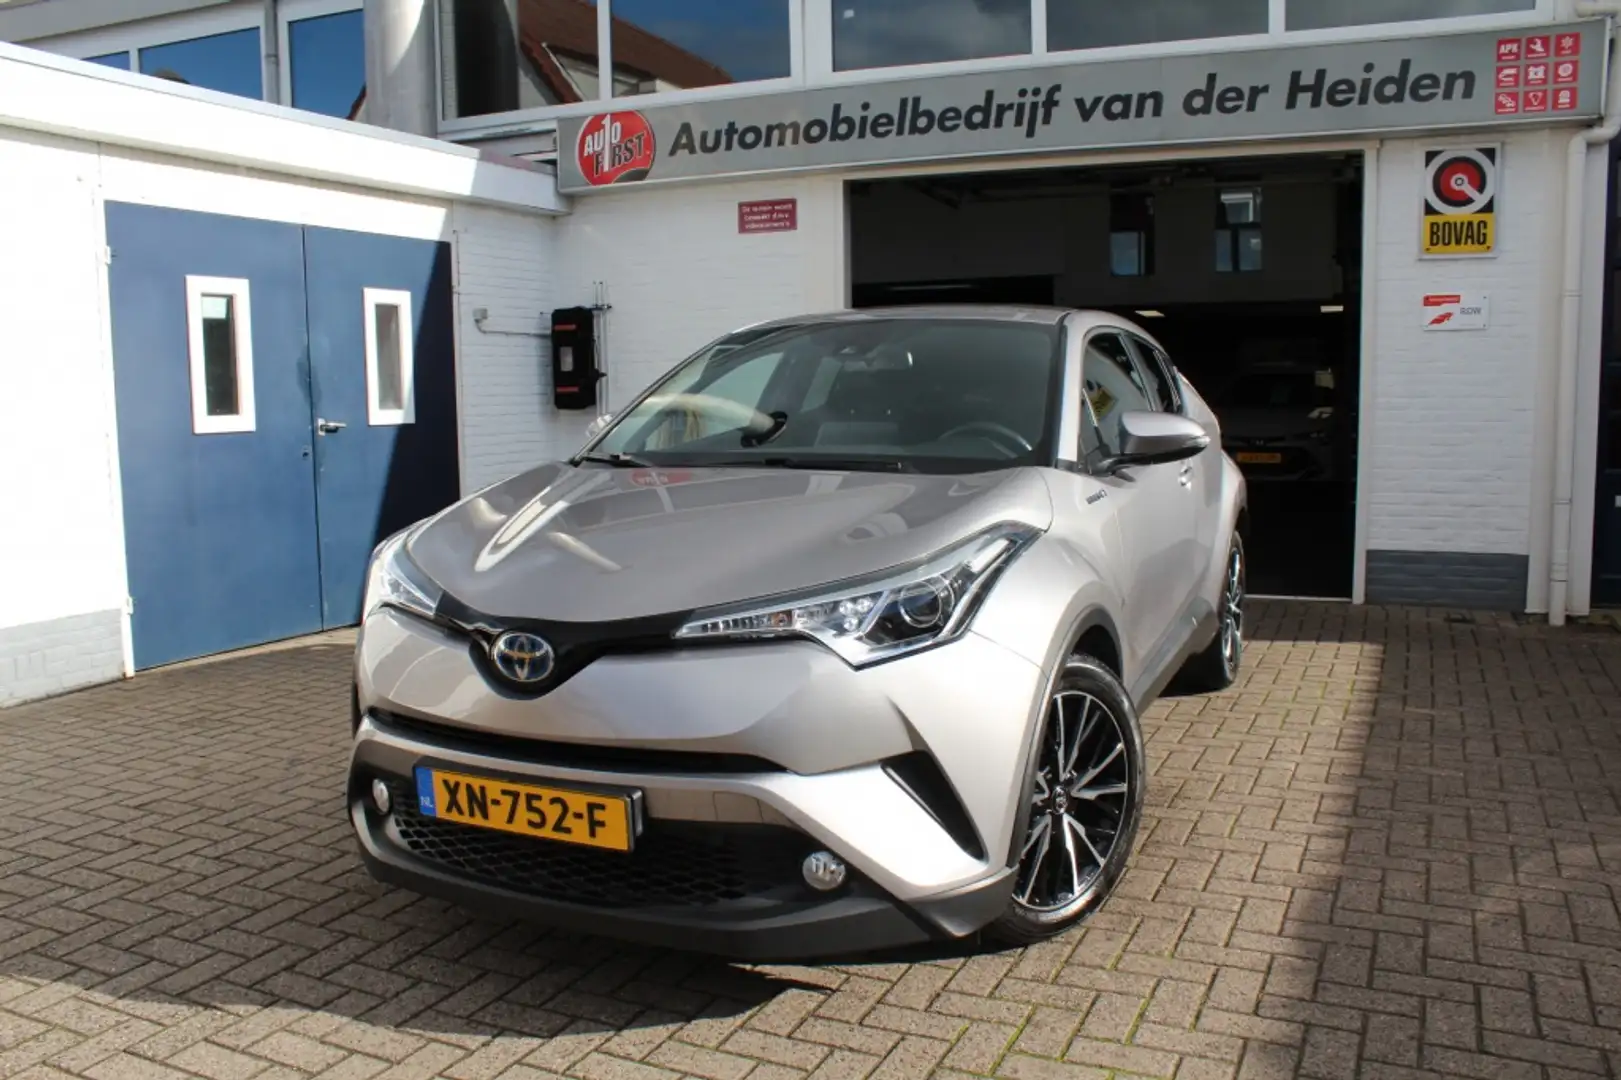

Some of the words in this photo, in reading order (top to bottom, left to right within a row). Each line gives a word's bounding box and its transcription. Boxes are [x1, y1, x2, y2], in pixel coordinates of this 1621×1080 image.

[668, 84, 1062, 157] Automobielbedrijf
[1074, 89, 1164, 122] van
[1182, 73, 1269, 116] der
[1285, 59, 1476, 110] Heiden
[1430, 220, 1488, 246] BOVAG
[420, 796, 434, 808] NL
[442, 778, 606, 838] XN-752-F
